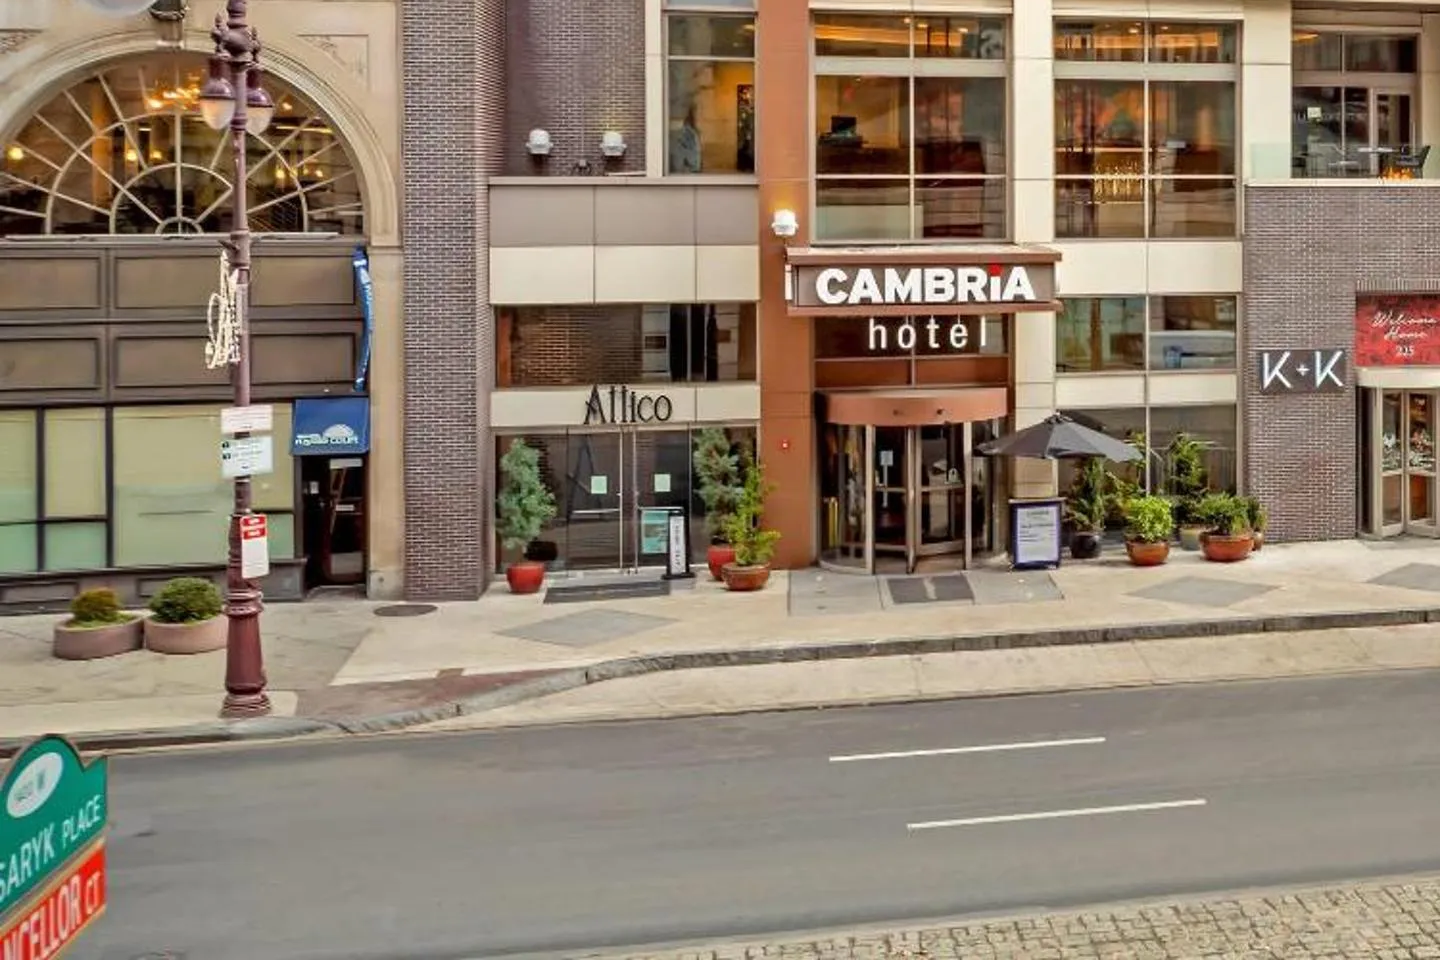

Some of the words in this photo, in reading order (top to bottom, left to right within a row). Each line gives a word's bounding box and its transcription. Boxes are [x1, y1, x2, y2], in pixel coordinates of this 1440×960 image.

[868, 316, 986, 349] hotel
[583, 383, 673, 425] Attico
[61, 794, 102, 850] PLACE
